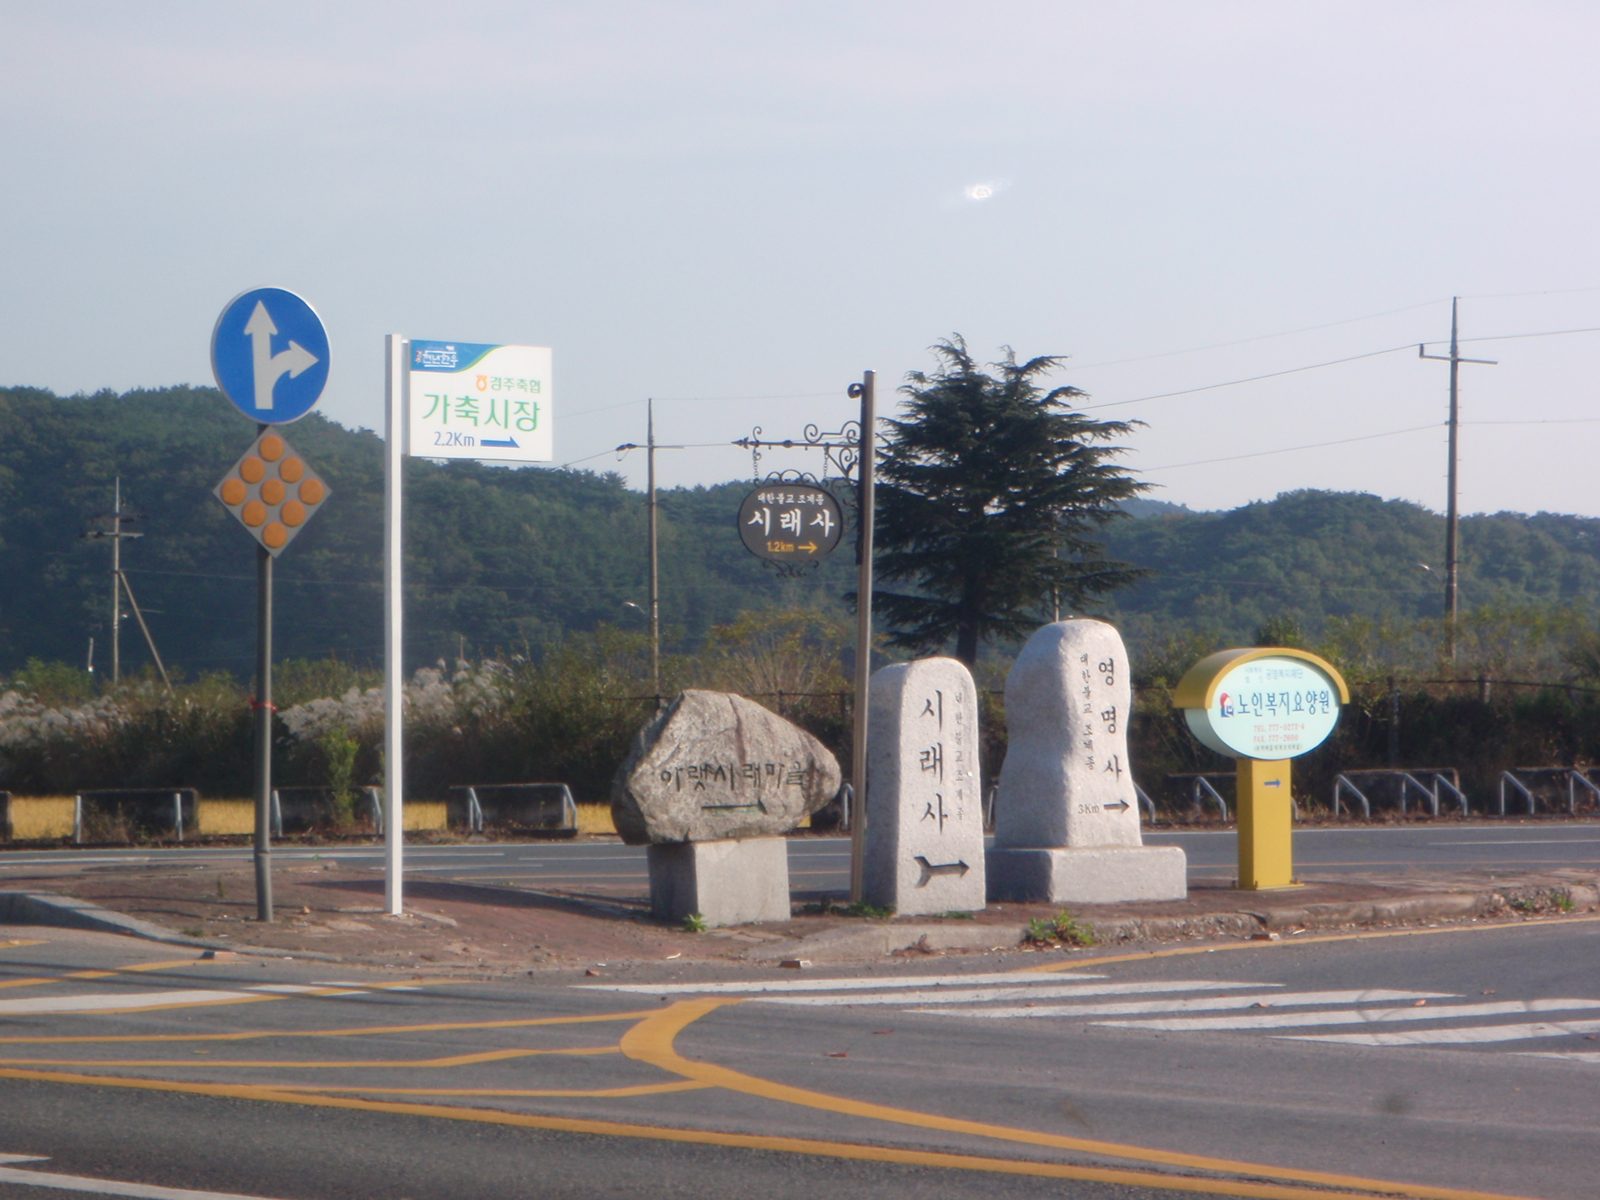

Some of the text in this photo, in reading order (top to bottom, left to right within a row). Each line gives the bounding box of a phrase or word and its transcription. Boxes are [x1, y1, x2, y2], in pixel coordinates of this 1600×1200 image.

[491, 376, 541, 393] 경주축협
[422, 394, 540, 432] 가축시장
[434, 431, 475, 447] 2.2Km
[747, 507, 834, 538] 시래사
[767, 541, 794, 552] 1.2km
[1238, 690, 1330, 717] 노인복지요양원
[1098, 658, 1122, 783] 영명사
[919, 689, 948, 836] 시래사
